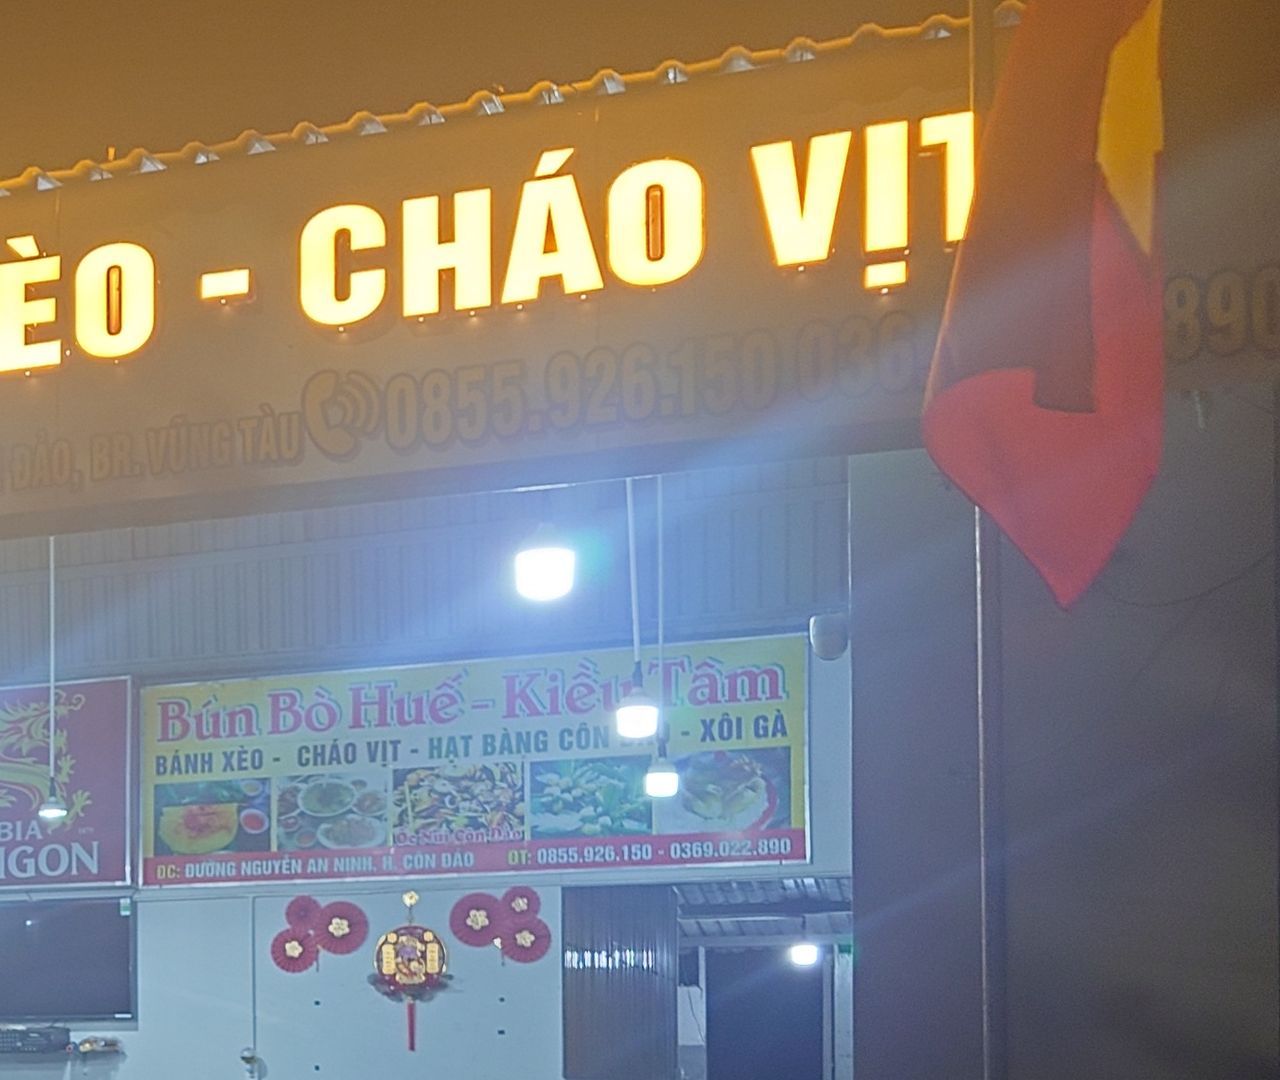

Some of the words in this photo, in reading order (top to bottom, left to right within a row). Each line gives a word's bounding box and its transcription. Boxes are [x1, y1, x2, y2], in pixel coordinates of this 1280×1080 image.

[299, 148, 704, 326] CHÁO
[750, 111, 975, 289] VỊT
[144, 413, 235, 478] VŨNG
[239, 402, 306, 467] TÀU
[385, 326, 781, 454] 0855.926.150
[155, 750, 214, 777] BÁNH
[222, 745, 264, 772] XÈO
[297, 738, 358, 768] CHÁO
[366, 739, 402, 771] VỊT
[428, 734, 473, 764] HẠT
[482, 727, 549, 756] BÀNG
[558, 722, 610, 750] CÔN
[700, 712, 743, 743] XÔI
[752, 708, 789, 739] GÀ
[156, 694, 260, 743] Bún
[267, 687, 342, 736] Bò
[347, 667, 468, 730] Huế
[501, 657, 634, 719] Kiều
[647, 653, 789, 708] Tâm
[240, 853, 300, 876] NGUYỄN
[306, 858, 329, 874] AN
[402, 850, 437, 870] CÔN
[441, 848, 476, 868] ĐẢO
[536, 843, 653, 864] 0855.926.150
[669, 838, 792, 859] 0369.022.890
